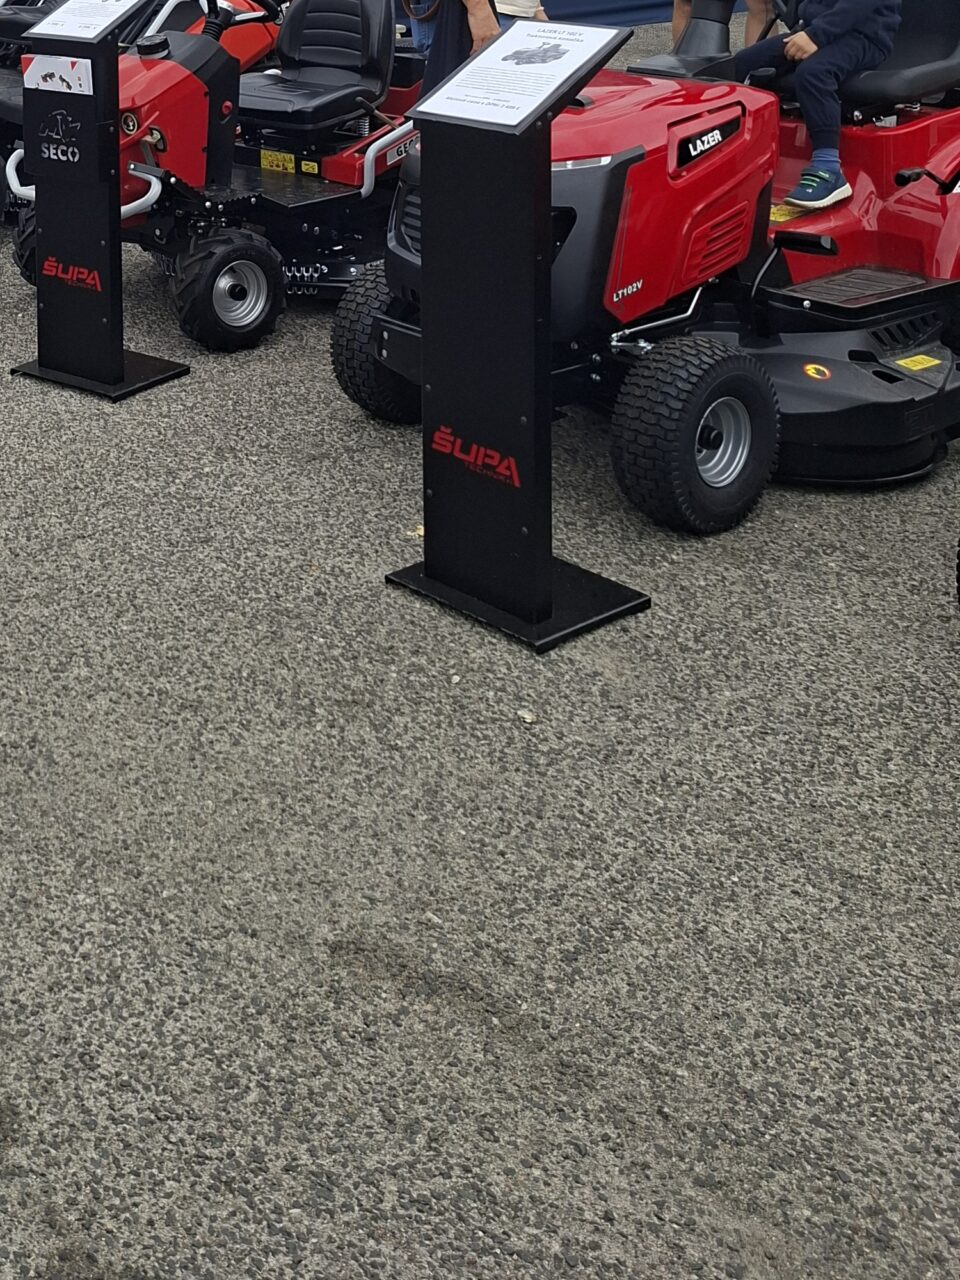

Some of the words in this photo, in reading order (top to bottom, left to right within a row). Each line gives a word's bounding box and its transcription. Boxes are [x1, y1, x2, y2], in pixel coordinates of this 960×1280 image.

[41, 142, 80, 163] SECO
[688, 129, 722, 157] LAZER
[42, 256, 102, 292] ŠUPA
[613, 279, 643, 302] LT102V
[431, 425, 521, 489] ŠUPA
